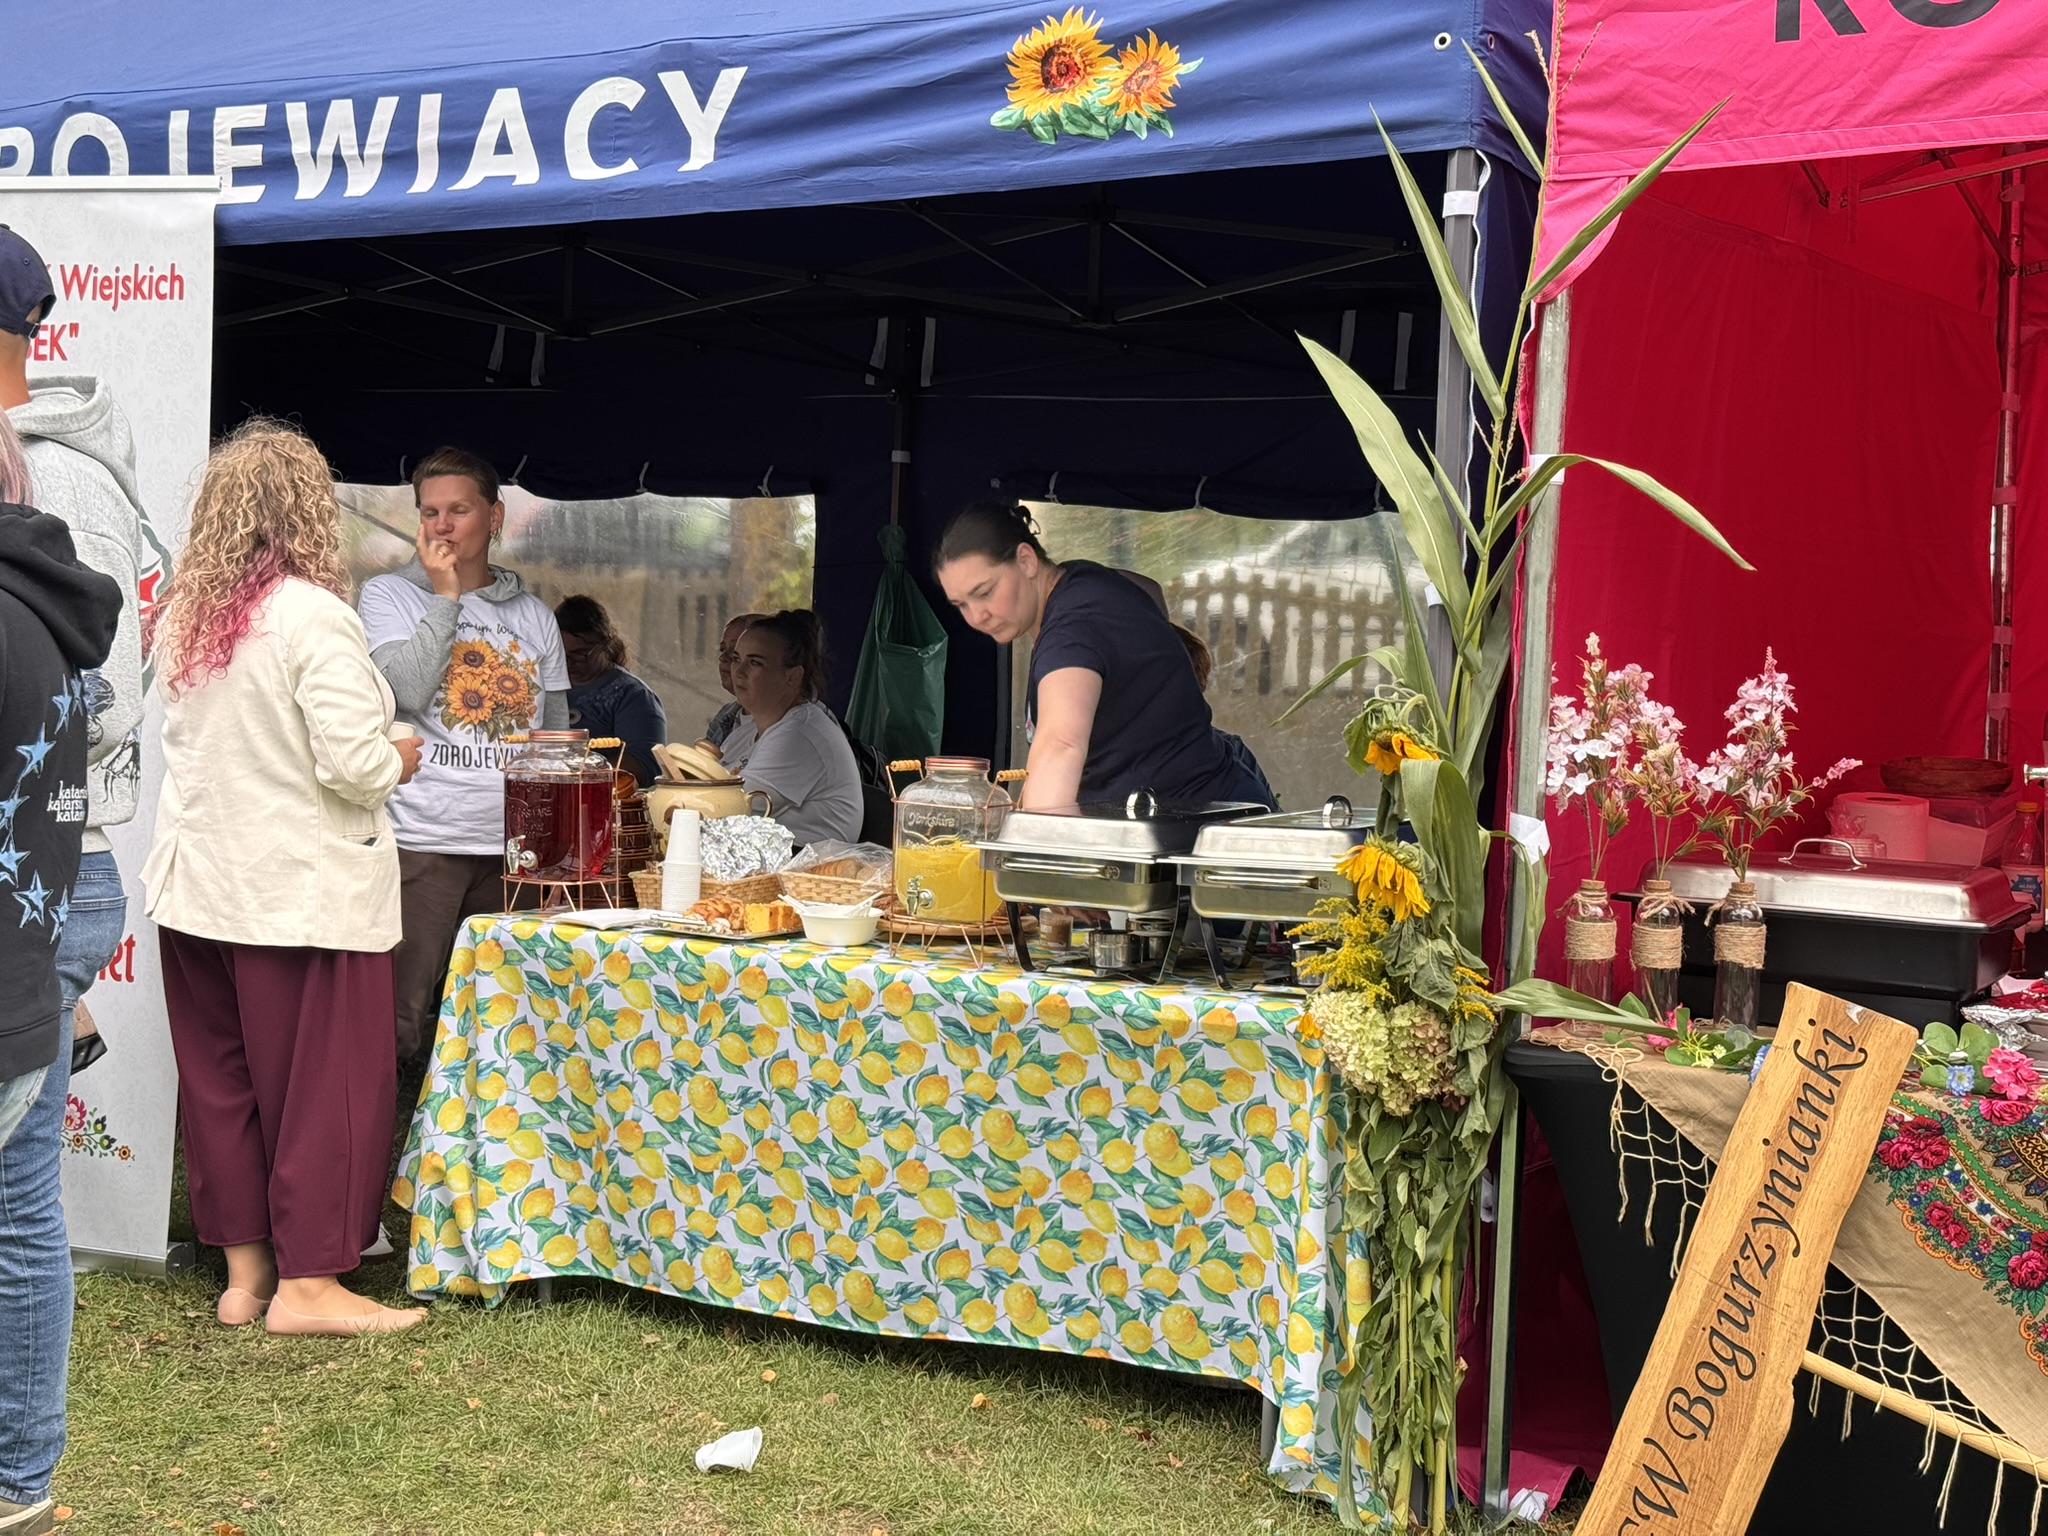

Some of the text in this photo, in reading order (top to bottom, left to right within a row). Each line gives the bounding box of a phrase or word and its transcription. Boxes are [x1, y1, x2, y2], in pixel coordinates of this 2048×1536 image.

[60, 263, 185, 311] Wiejskich
[26, 323, 79, 361] EK"
[1618, 1018, 1868, 1536] W Bogurzynianki
